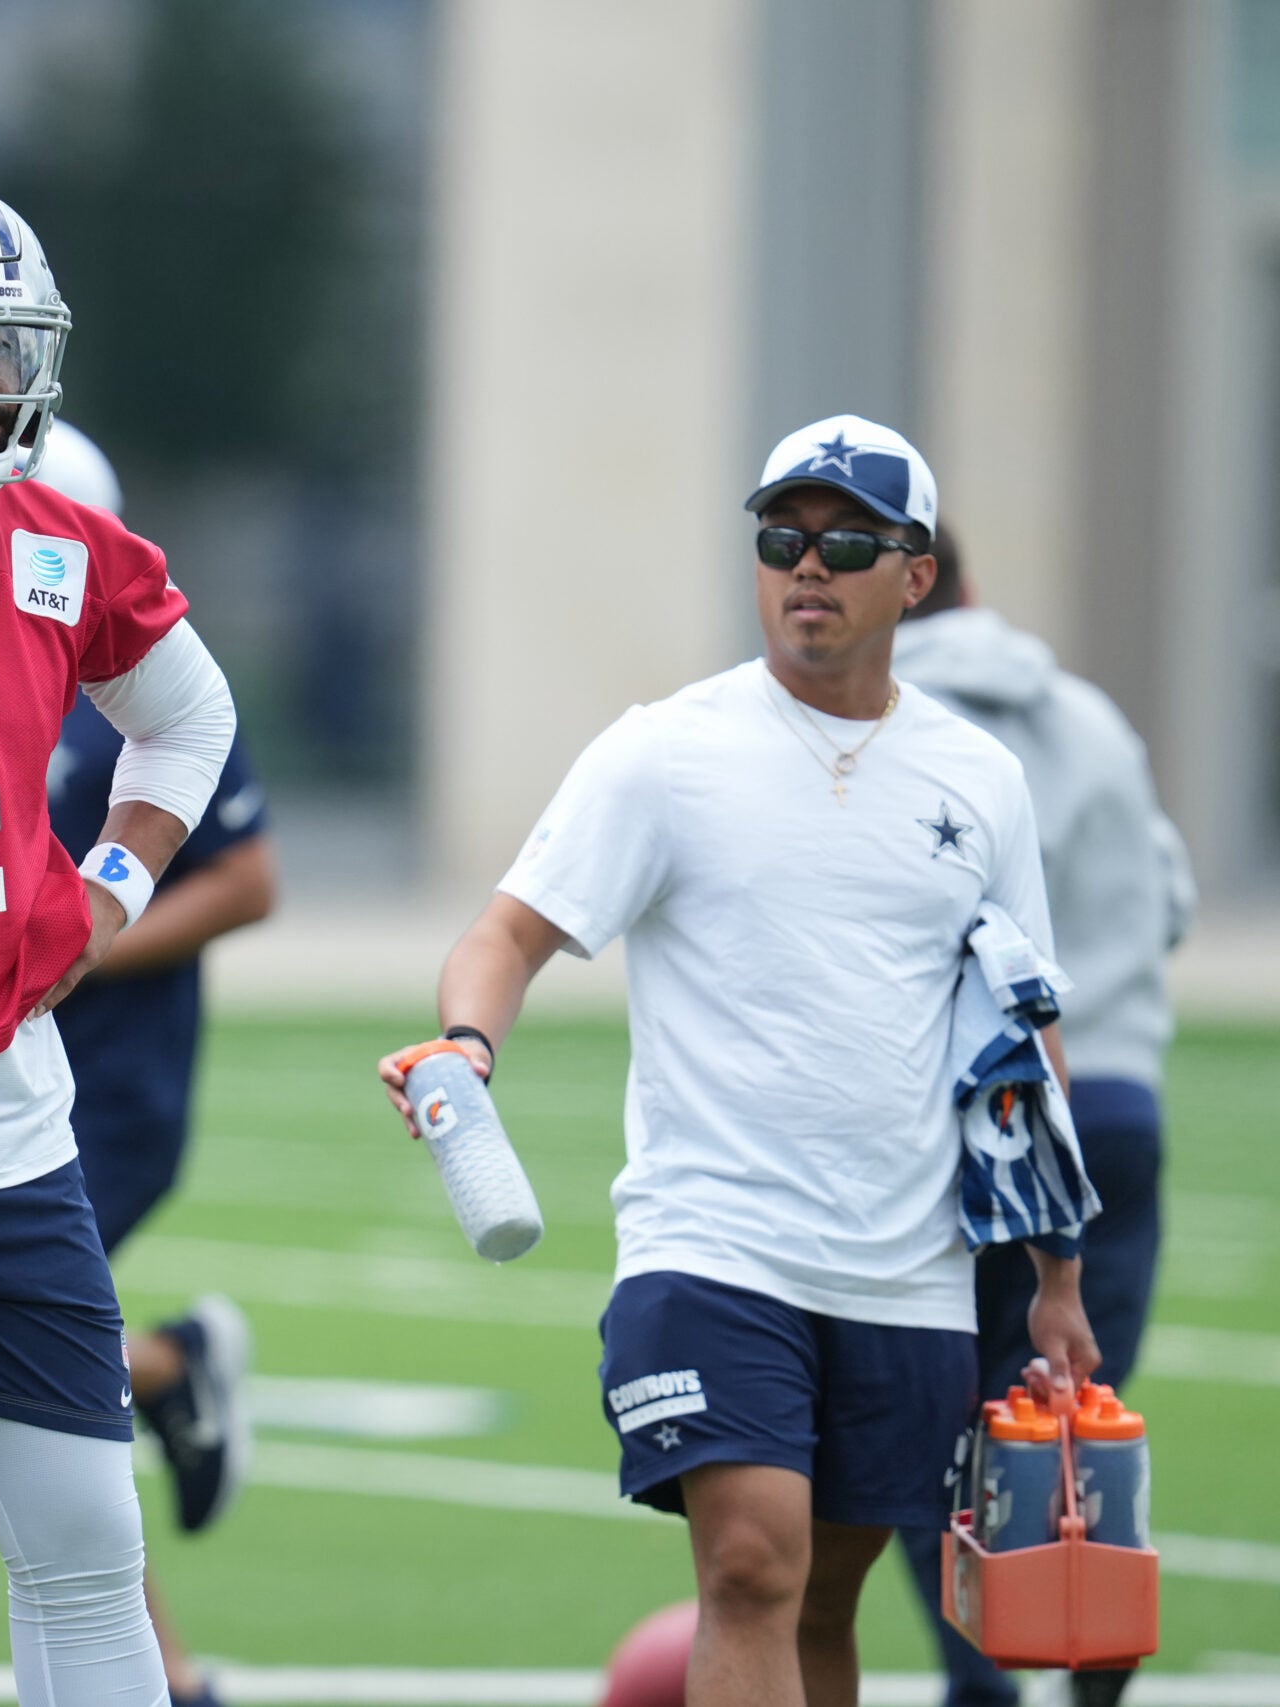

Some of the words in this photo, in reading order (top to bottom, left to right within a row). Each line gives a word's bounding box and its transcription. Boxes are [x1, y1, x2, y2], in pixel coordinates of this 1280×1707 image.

[28, 588, 69, 612] AT&T
[97, 847, 130, 882] 4
[418, 1086, 459, 1140] G
[608, 1369, 702, 1413] COWBOYS
